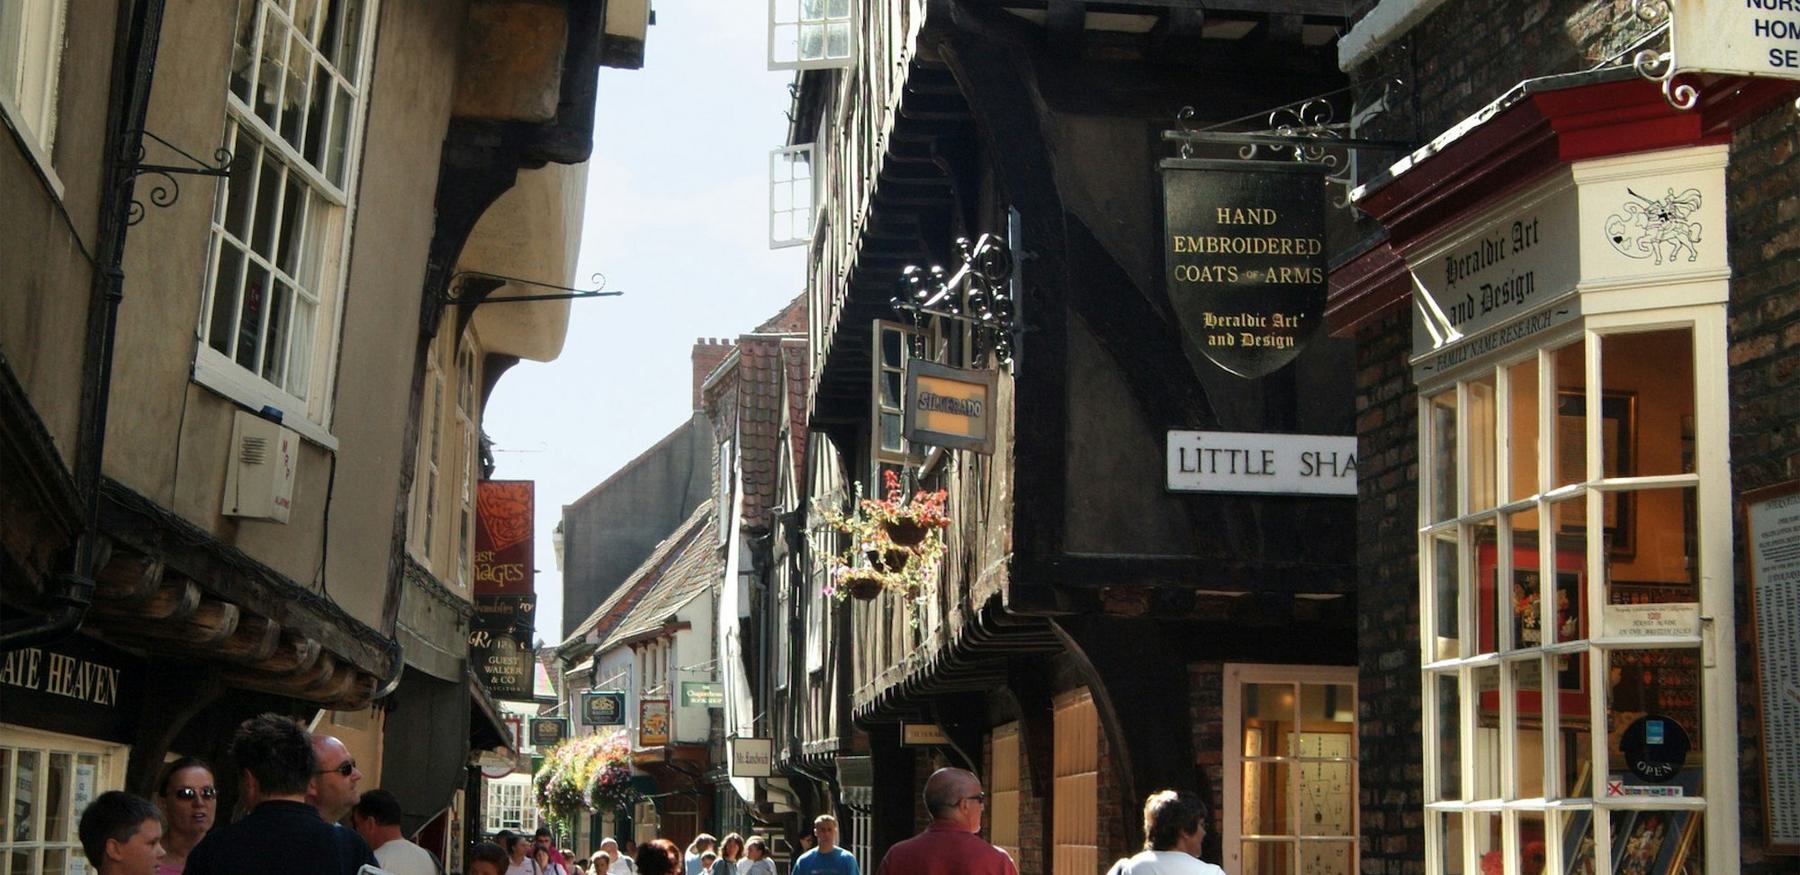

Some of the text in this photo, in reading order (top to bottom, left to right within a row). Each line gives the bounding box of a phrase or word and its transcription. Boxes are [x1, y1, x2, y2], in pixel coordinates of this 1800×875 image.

[1747, 0, 1800, 12] NUR
[1755, 18, 1800, 40] HOM
[1769, 48, 1799, 68] SE
[1216, 207, 1277, 225] HAND
[1173, 236, 1322, 255] EMBROIDERED
[1445, 216, 1539, 288] Heraldic Art
[1174, 264, 1239, 283] COATS
[1265, 266, 1323, 284] ARMS
[1450, 269, 1535, 326] and Design
[1203, 312, 1298, 329] Heraldic Art
[1208, 332, 1294, 349] and Design
[1436, 310, 1552, 371] FAMILY NAME RESEARCH
[919, 391, 982, 417] SILVERADO
[1179, 447, 1357, 478] LITTLE SHA
[475, 551, 496, 562] ast
[484, 665, 523, 675] WALKER
[488, 656, 520, 665] GUEST
[0, 648, 120, 707] ATE HEAVEN
[500, 676, 516, 684] CO
[1636, 761, 1673, 777] OPEN
